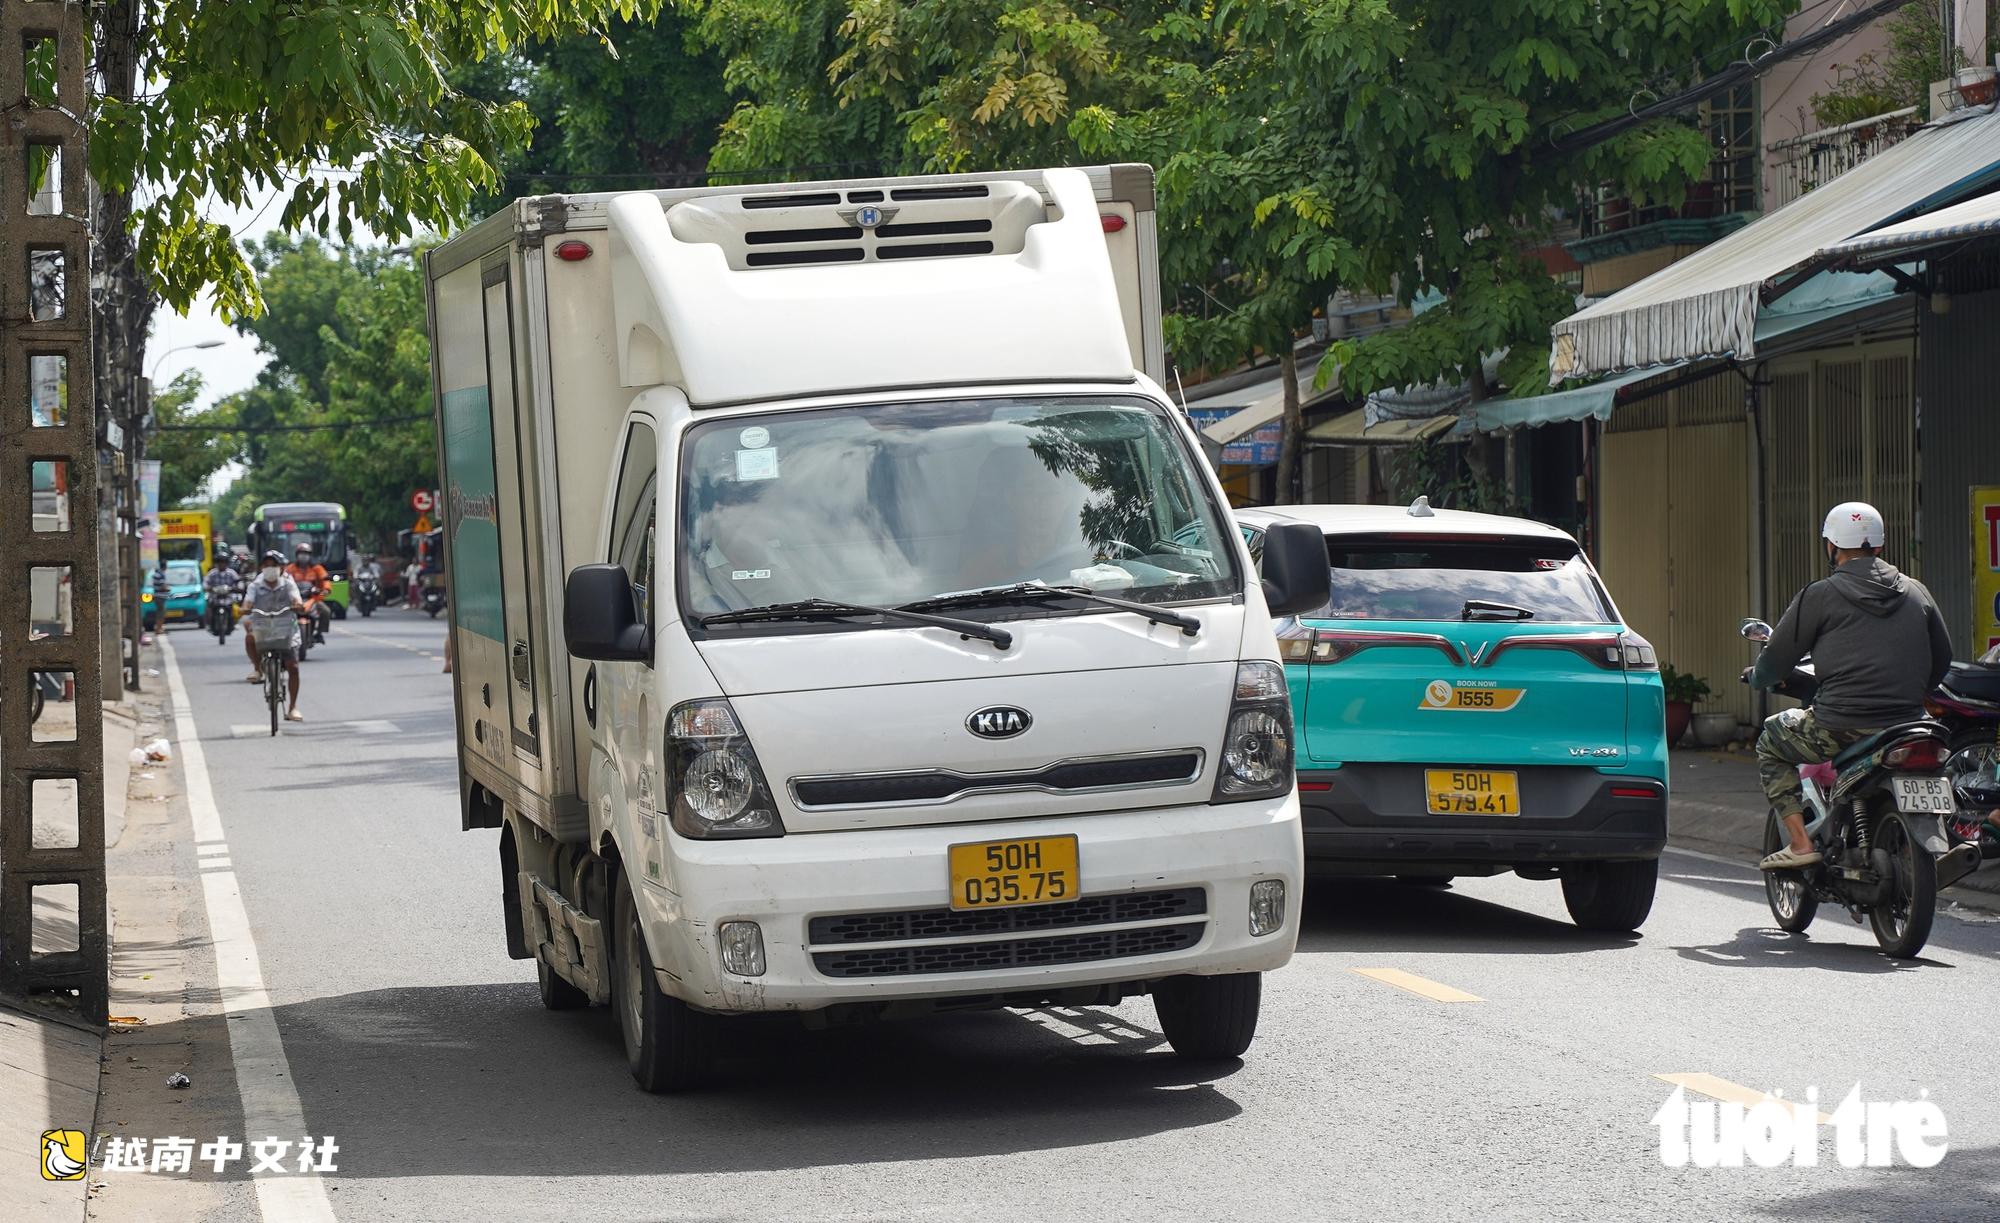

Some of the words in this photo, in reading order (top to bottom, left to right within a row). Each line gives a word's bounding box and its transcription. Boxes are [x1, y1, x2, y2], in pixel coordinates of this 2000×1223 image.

[1456, 680, 1477, 688] BOOK
[1477, 680, 1497, 688] NOW!
[1457, 691, 1494, 706] 1555
[977, 711, 1023, 732] KIA
[1453, 772, 1492, 792] 50H
[1902, 780, 1943, 795] 60-B5
[1438, 793, 1507, 813] 579.41
[1899, 795, 1952, 811] 745.08
[986, 842, 1042, 872] 50H
[965, 871, 1066, 905] 035.75
